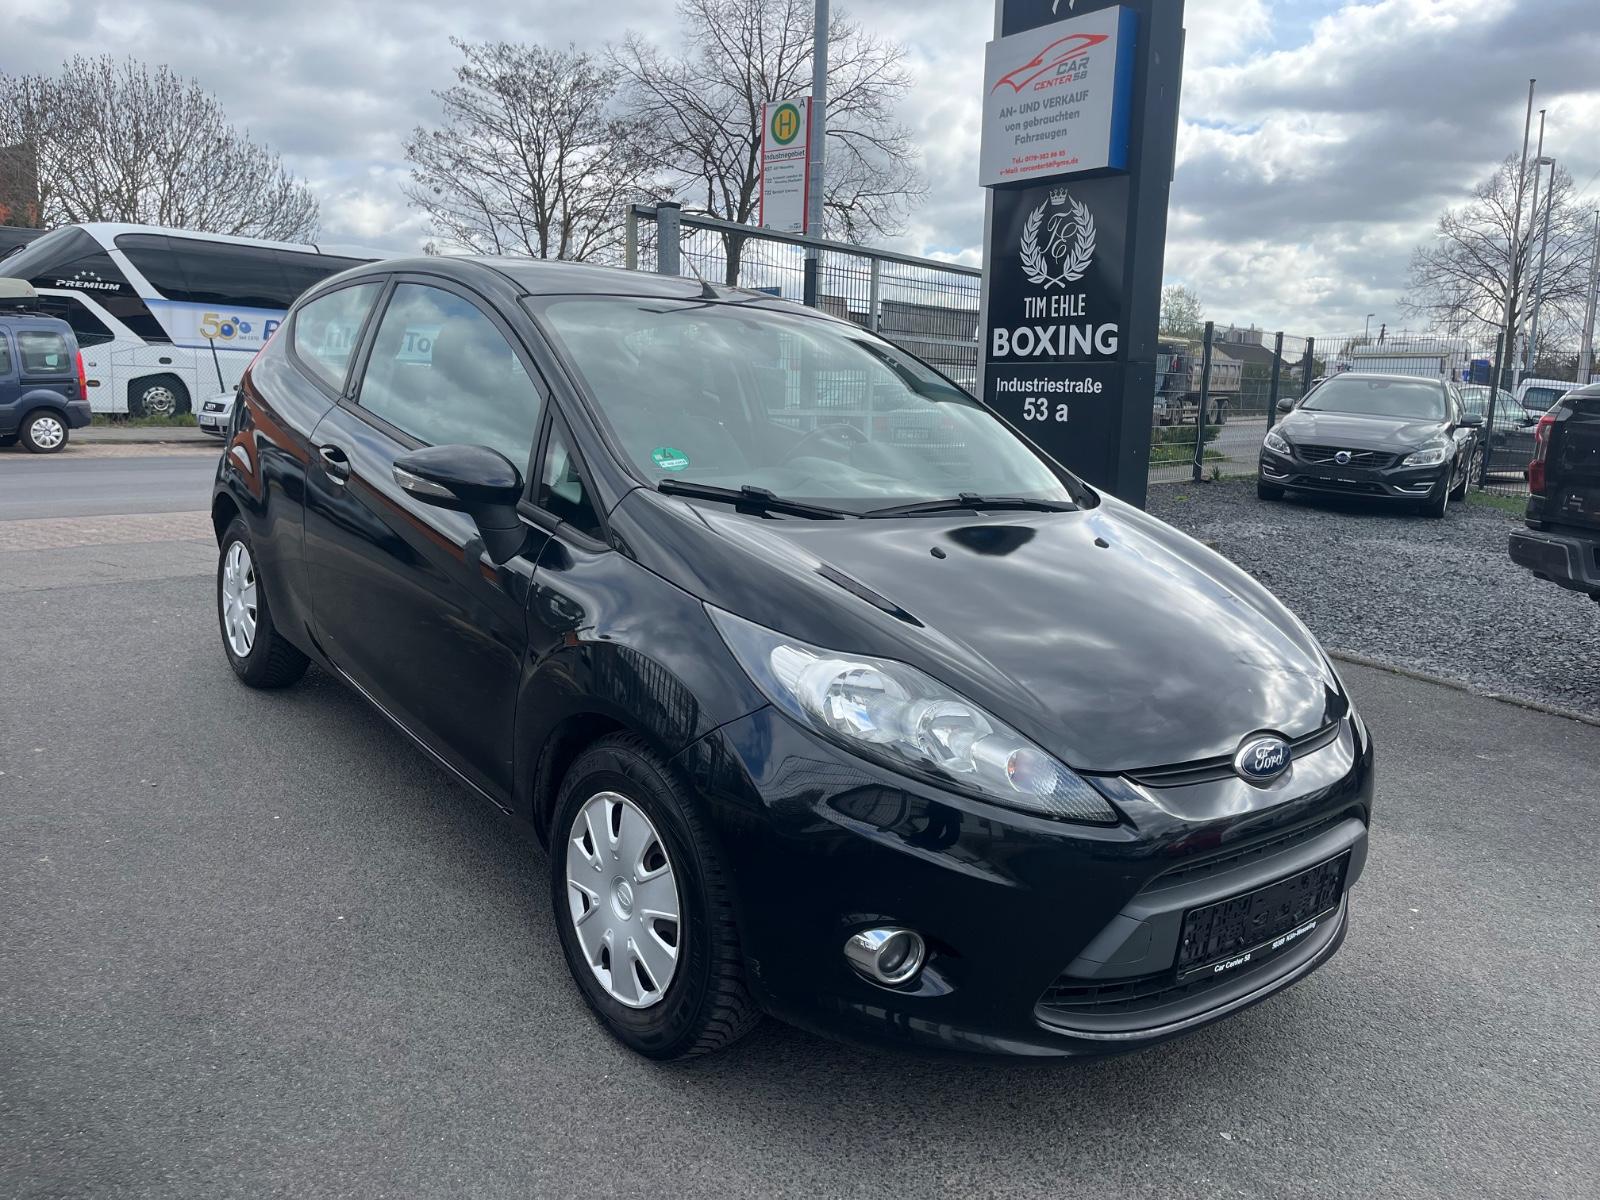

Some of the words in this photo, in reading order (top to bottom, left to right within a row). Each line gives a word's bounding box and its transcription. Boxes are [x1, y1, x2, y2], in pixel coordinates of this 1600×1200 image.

[1056, 57, 1090, 75] CAR
[1033, 74, 1072, 91] CENTER
[799, 99, 806, 109] A
[999, 106, 1017, 119] AN-
[1019, 101, 1041, 114] UND
[1043, 90, 1089, 110] VERKAUF
[779, 112, 792, 137] H
[1005, 121, 1021, 132] von
[1023, 109, 1080, 130] gebrauchten
[1014, 127, 1068, 146] Fahrzeugen
[764, 150, 805, 161] Industriegebiet
[56, 279, 121, 291] PREMIUM
[1024, 296, 1046, 318] TIM
[1051, 294, 1086, 317] EHLE
[992, 322, 1119, 357] BOXING
[996, 377, 1102, 393] Industriestraße
[1023, 397, 1048, 422] 53
[1055, 403, 1068, 422] a
[1255, 745, 1284, 771] Ford
[1214, 964, 1225, 973] Car
[1225, 957, 1244, 969] Center
